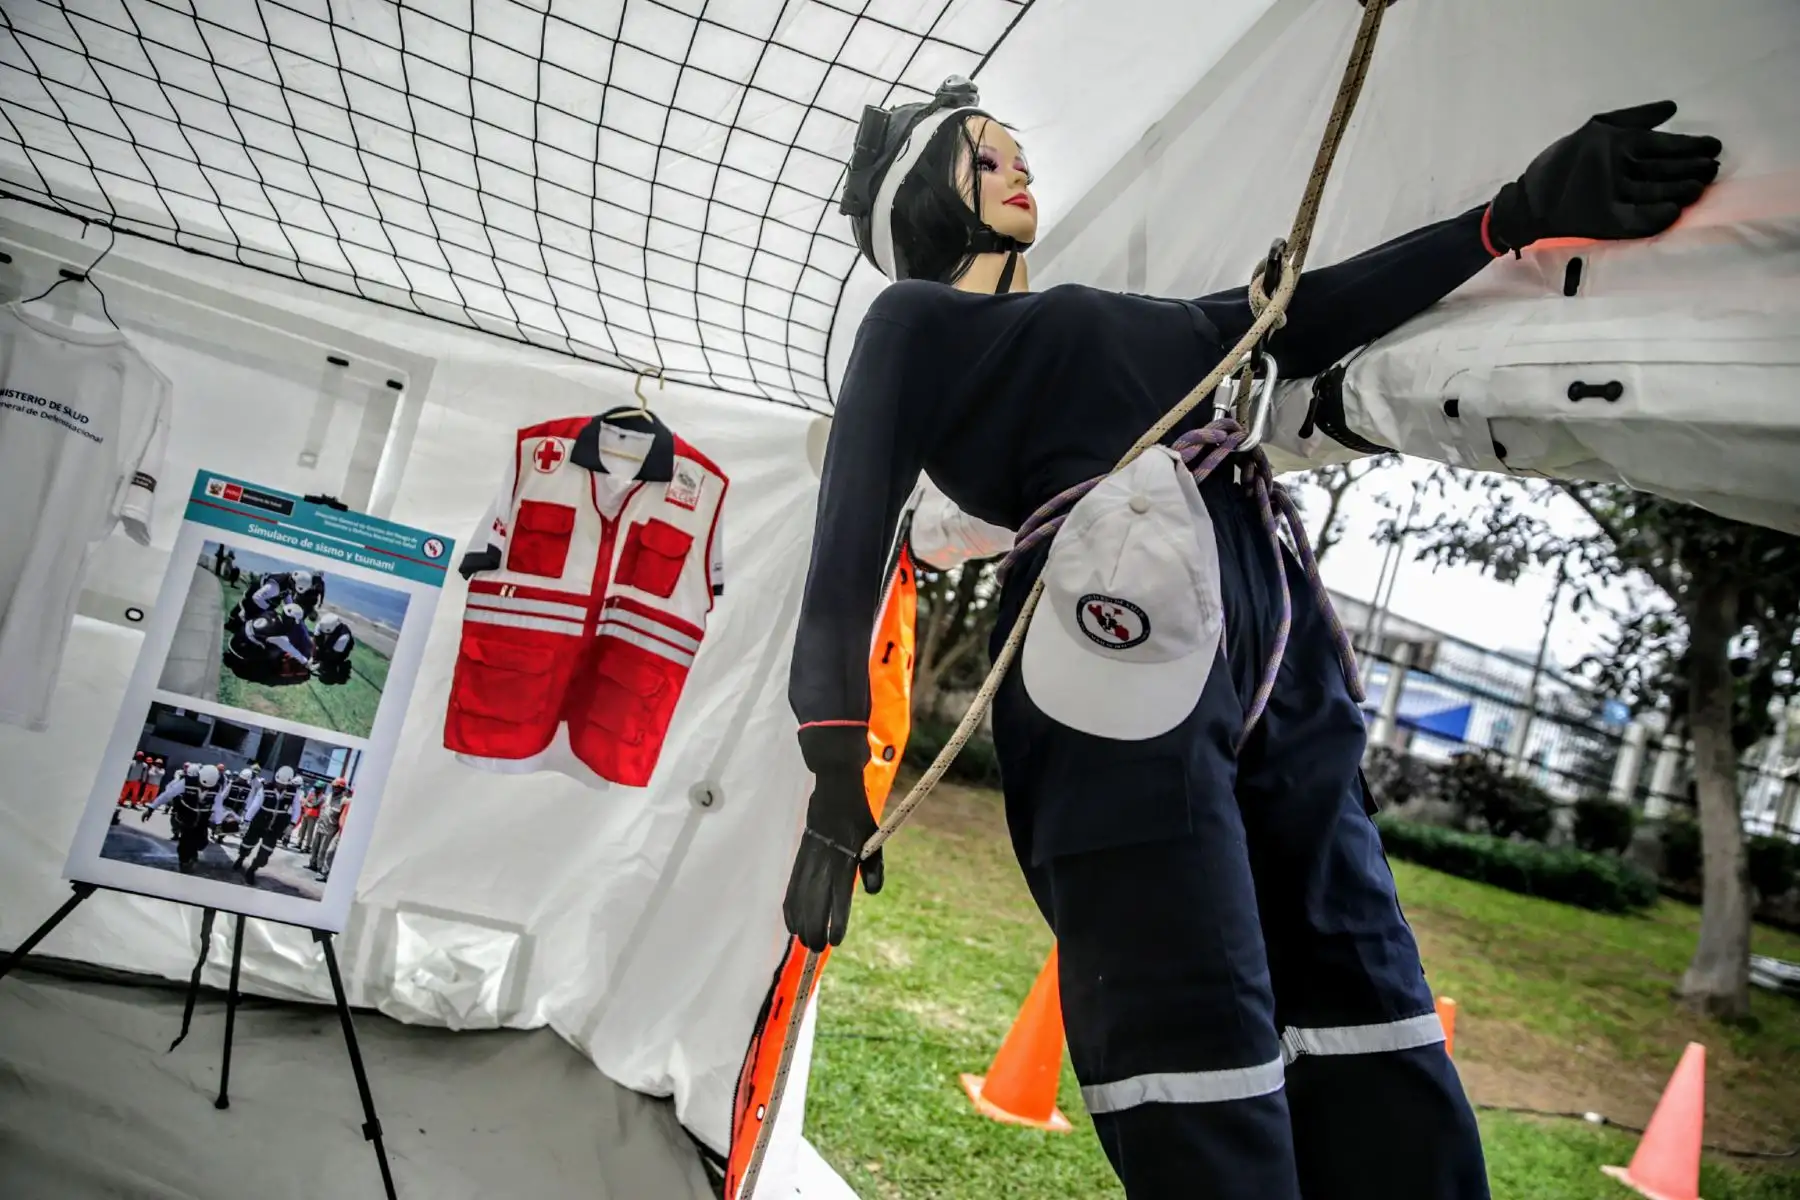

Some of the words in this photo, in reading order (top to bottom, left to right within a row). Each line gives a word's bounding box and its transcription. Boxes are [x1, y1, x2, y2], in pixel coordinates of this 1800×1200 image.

[0, 401, 25, 413] neral
[26, 407, 38, 416] de
[49, 400, 62, 411] DE
[63, 406, 89, 424] SLUD
[248, 524, 298, 545] Simulacro
[300, 537, 314, 549] de
[315, 542, 344, 558] sismo
[346, 551, 354, 561] y
[355, 552, 395, 571] tsunami
